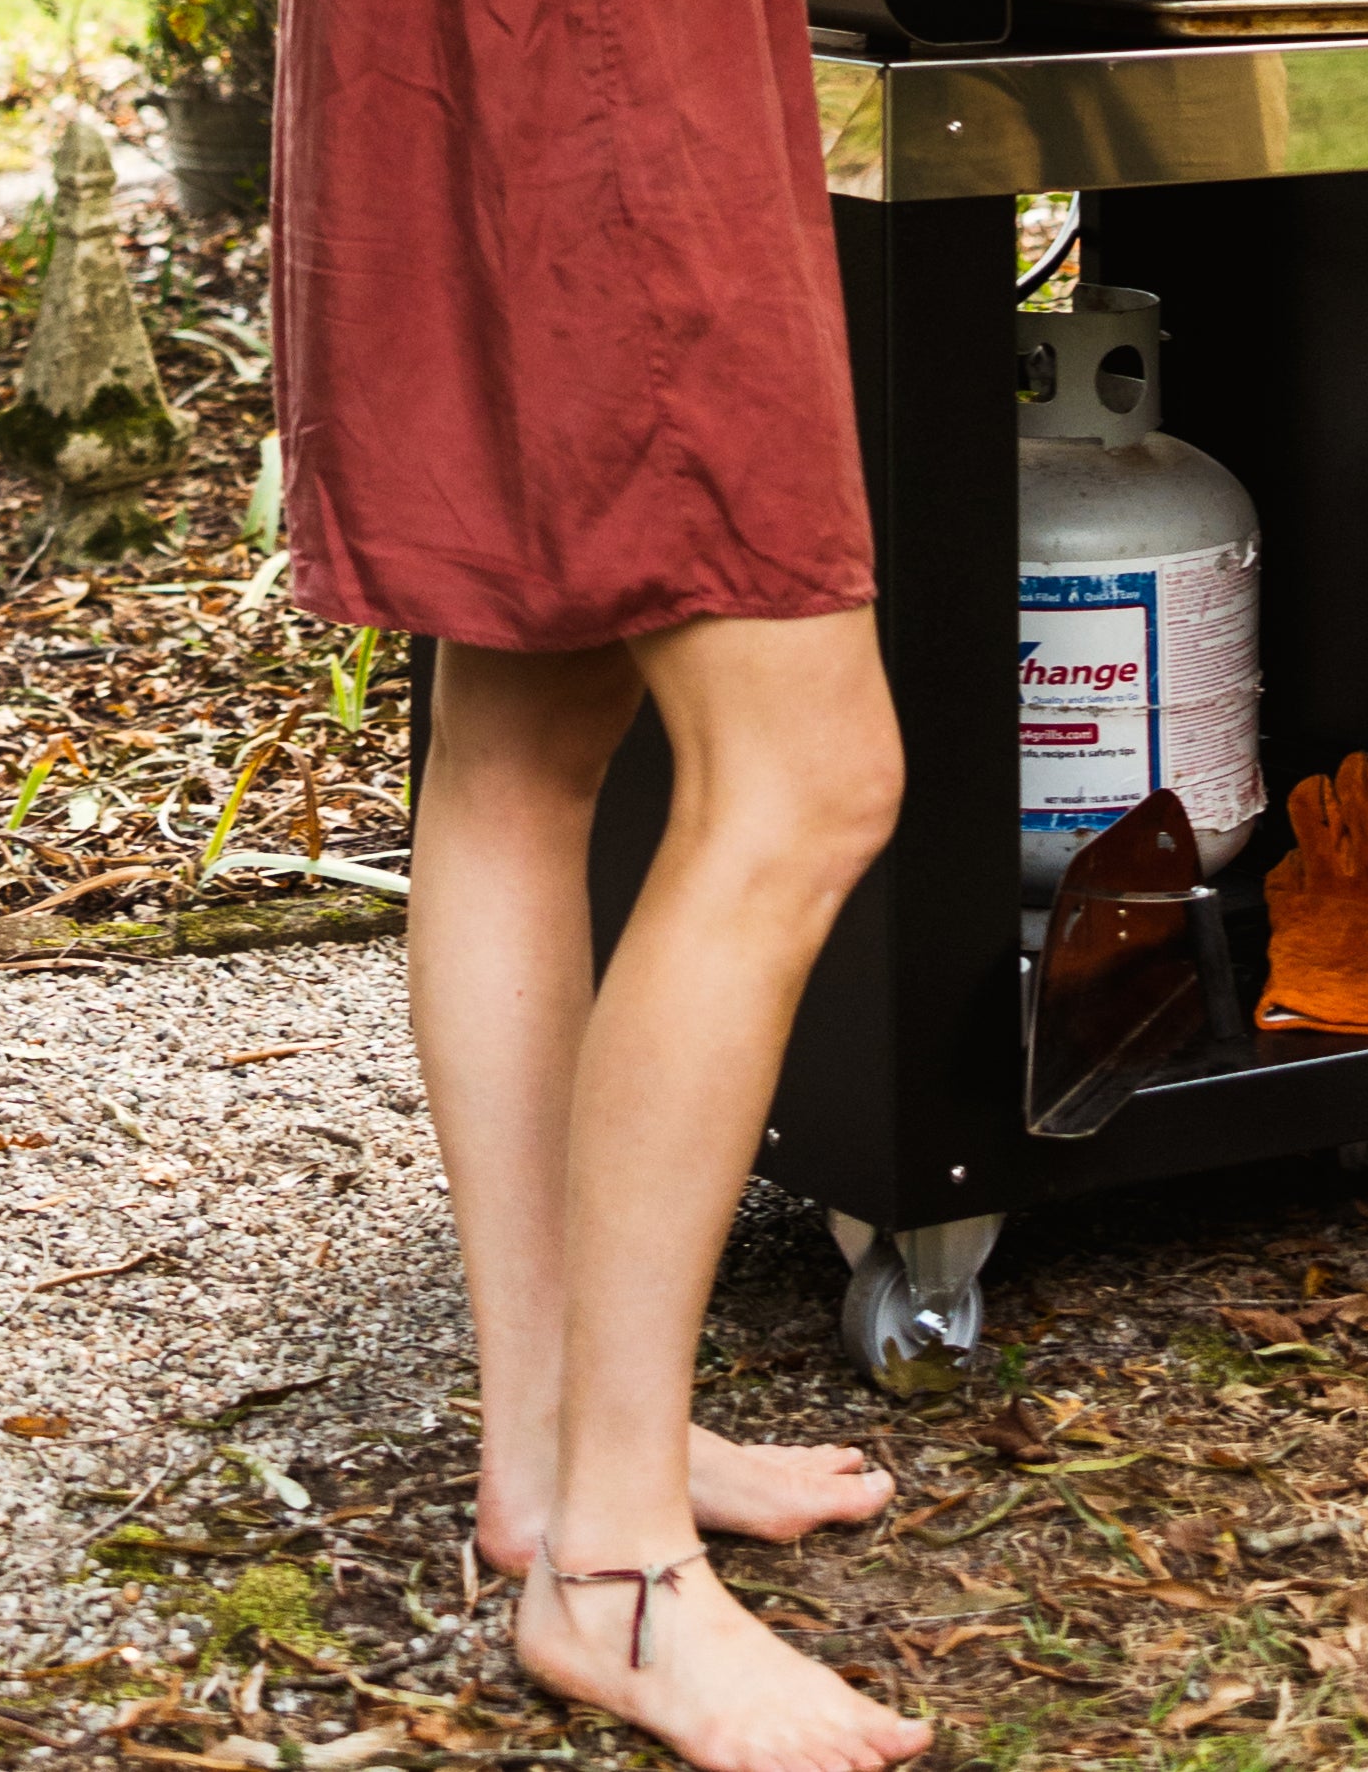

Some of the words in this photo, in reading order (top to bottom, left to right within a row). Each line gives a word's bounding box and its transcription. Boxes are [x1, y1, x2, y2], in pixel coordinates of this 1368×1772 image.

[1041, 749, 1076, 760] recipes
[1088, 748, 1116, 759] safety
[1118, 747, 1136, 757] tips
